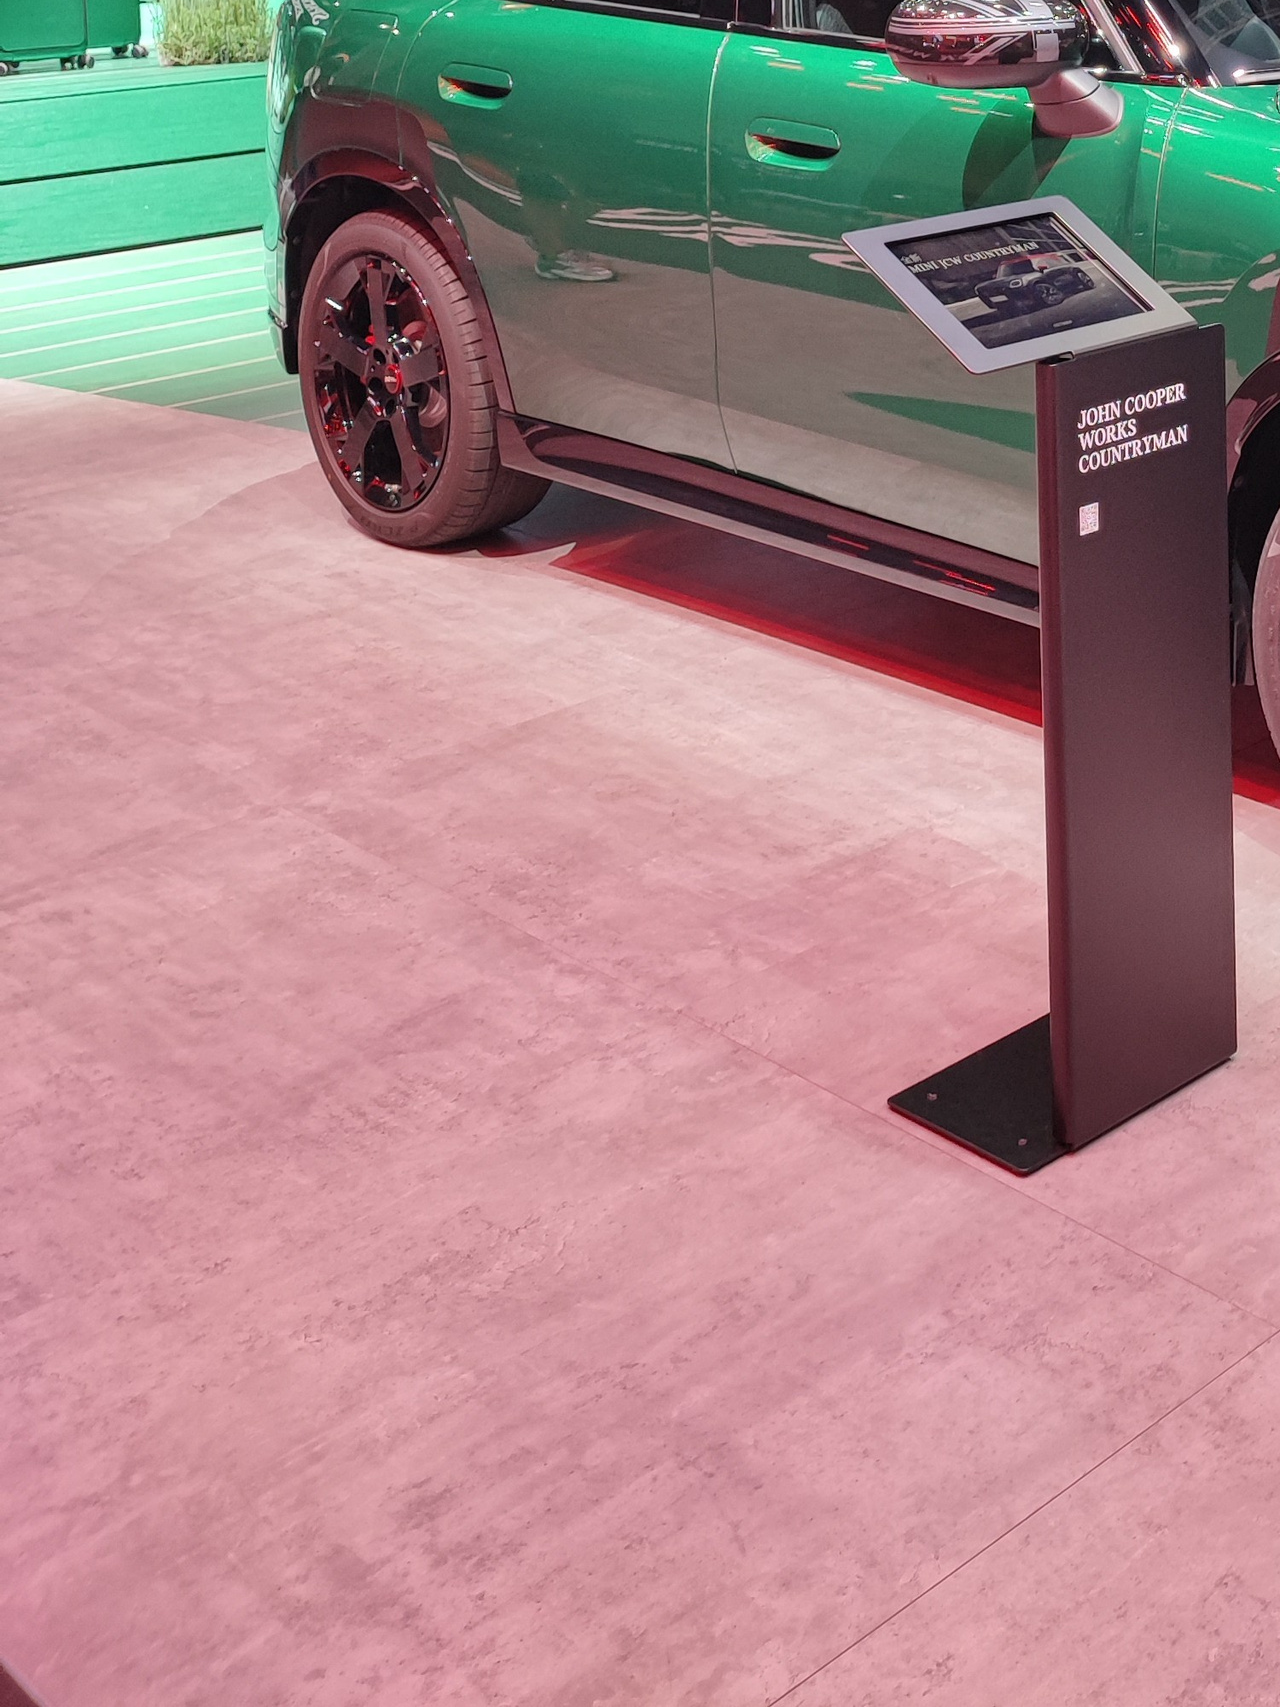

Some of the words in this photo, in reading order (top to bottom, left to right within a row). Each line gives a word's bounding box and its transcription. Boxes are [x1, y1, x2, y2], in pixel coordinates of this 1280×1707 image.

[907, 261, 940, 275] MINI
[939, 255, 963, 270] JCW
[963, 241, 1041, 263] COUNTRYMAN
[1077, 400, 1122, 430] JOHN
[1124, 382, 1187, 416] COOPER
[1077, 418, 1138, 452] WORKS
[1078, 423, 1189, 474] COUNTRYMAN
